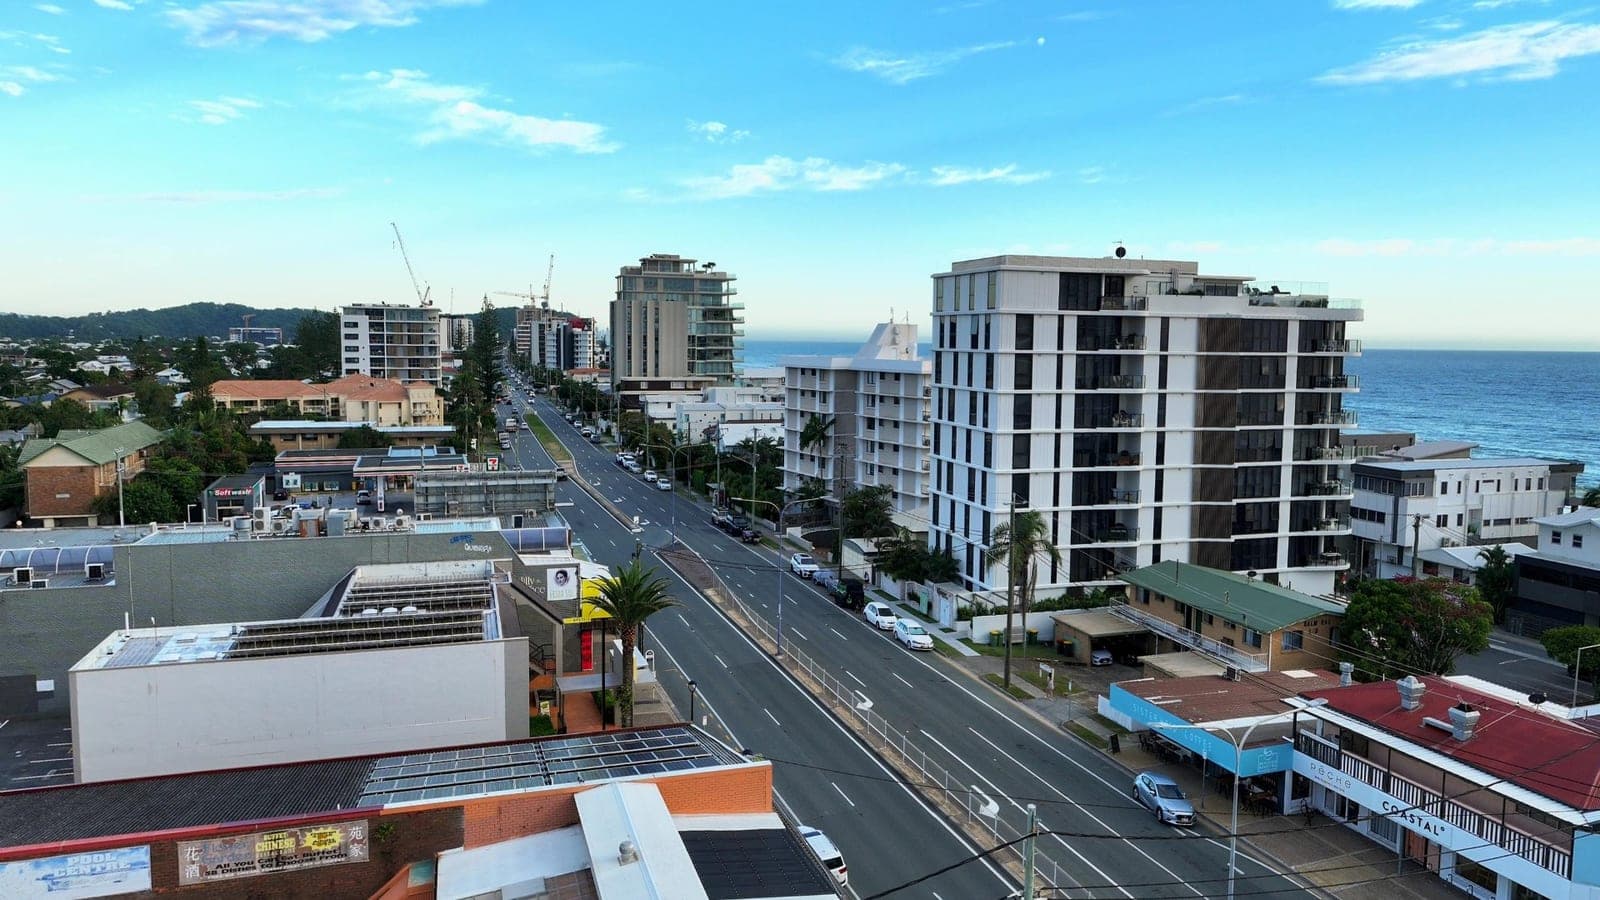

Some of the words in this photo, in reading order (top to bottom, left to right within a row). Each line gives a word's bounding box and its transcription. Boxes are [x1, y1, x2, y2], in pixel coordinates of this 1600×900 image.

[256, 838, 296, 852] CHINESE
[67, 852, 117, 866] POOL
[215, 862, 231, 870] All
[56, 862, 132, 877] CENTRE
